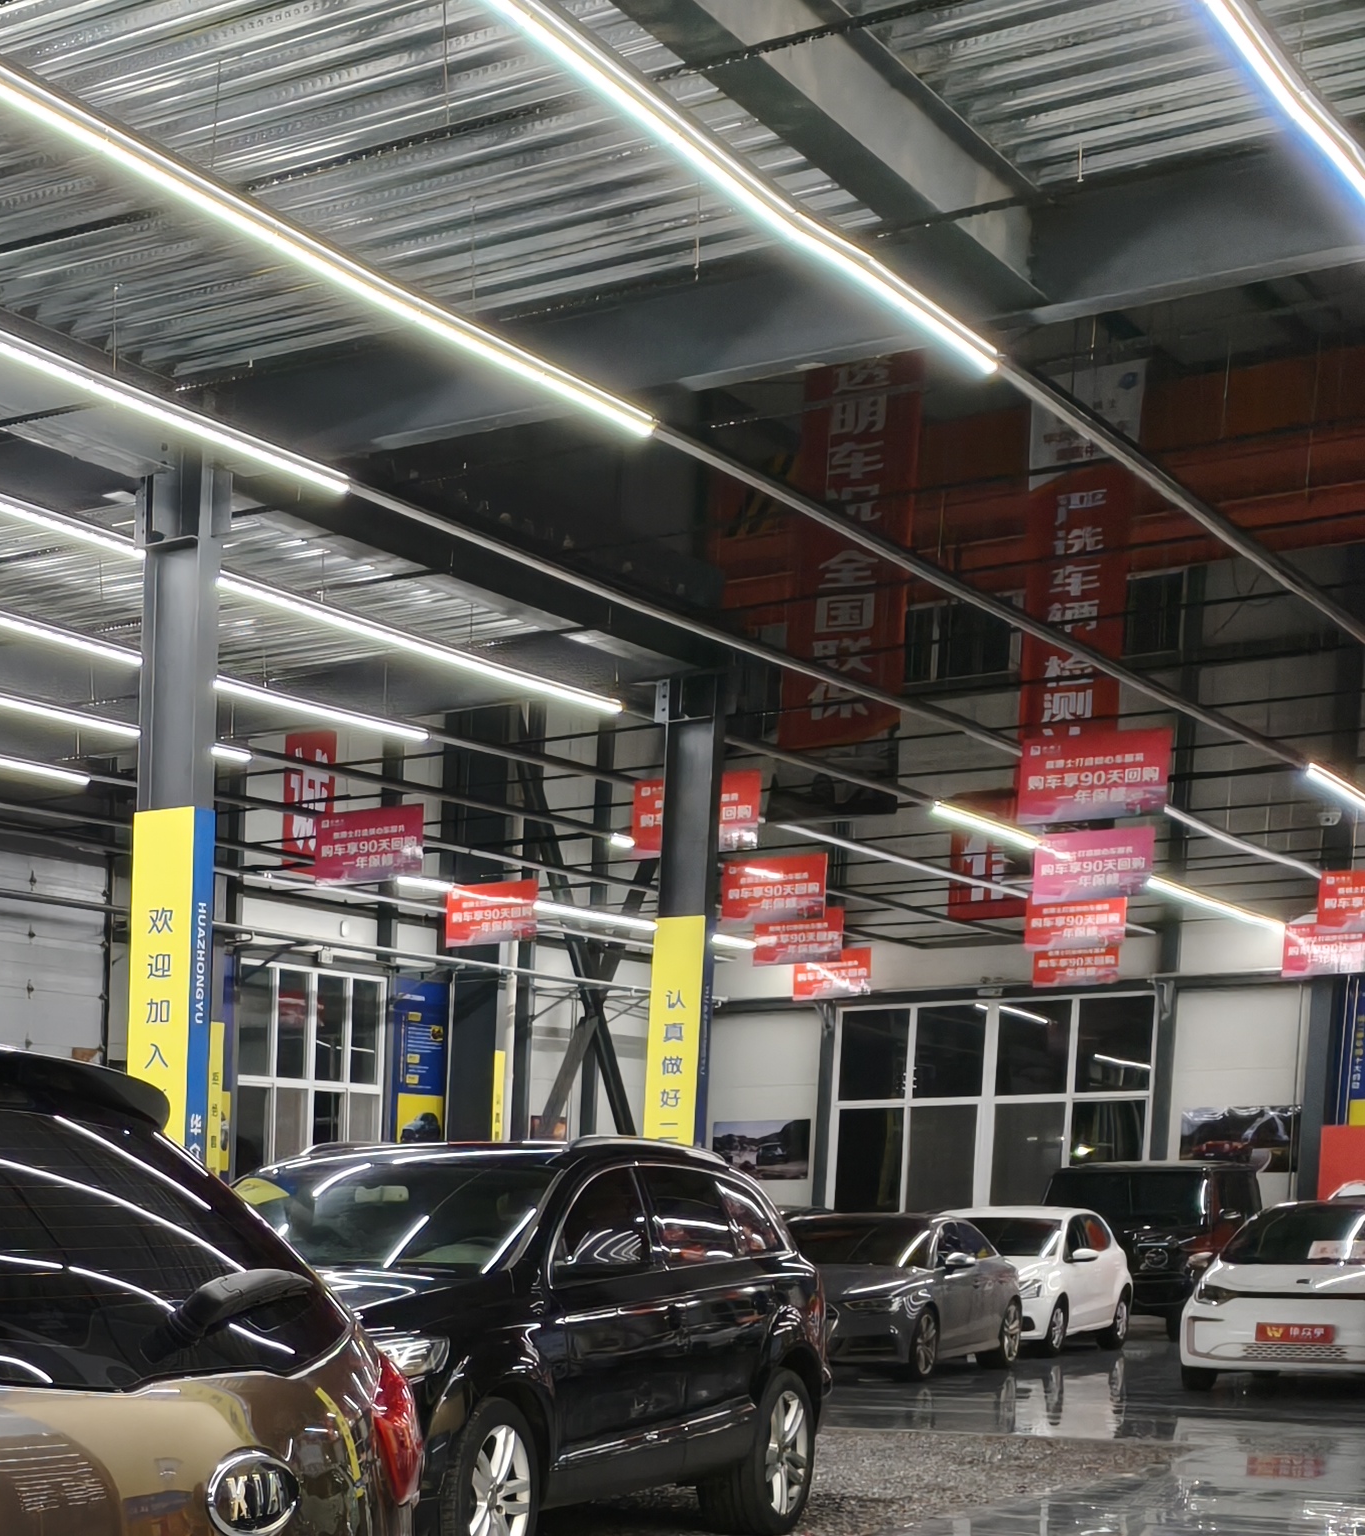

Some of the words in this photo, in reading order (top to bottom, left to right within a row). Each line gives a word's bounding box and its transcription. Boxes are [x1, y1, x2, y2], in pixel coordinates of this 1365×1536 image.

[1027, 766, 1160, 791] 购车享90天回购
[321, 836, 418, 858] 购车享90天回购
[1040, 856, 1146, 876] 购车享90天回购
[194, 901, 207, 1025] HUAZHONGYU
[143, 906, 174, 1070] 欢迎加入
